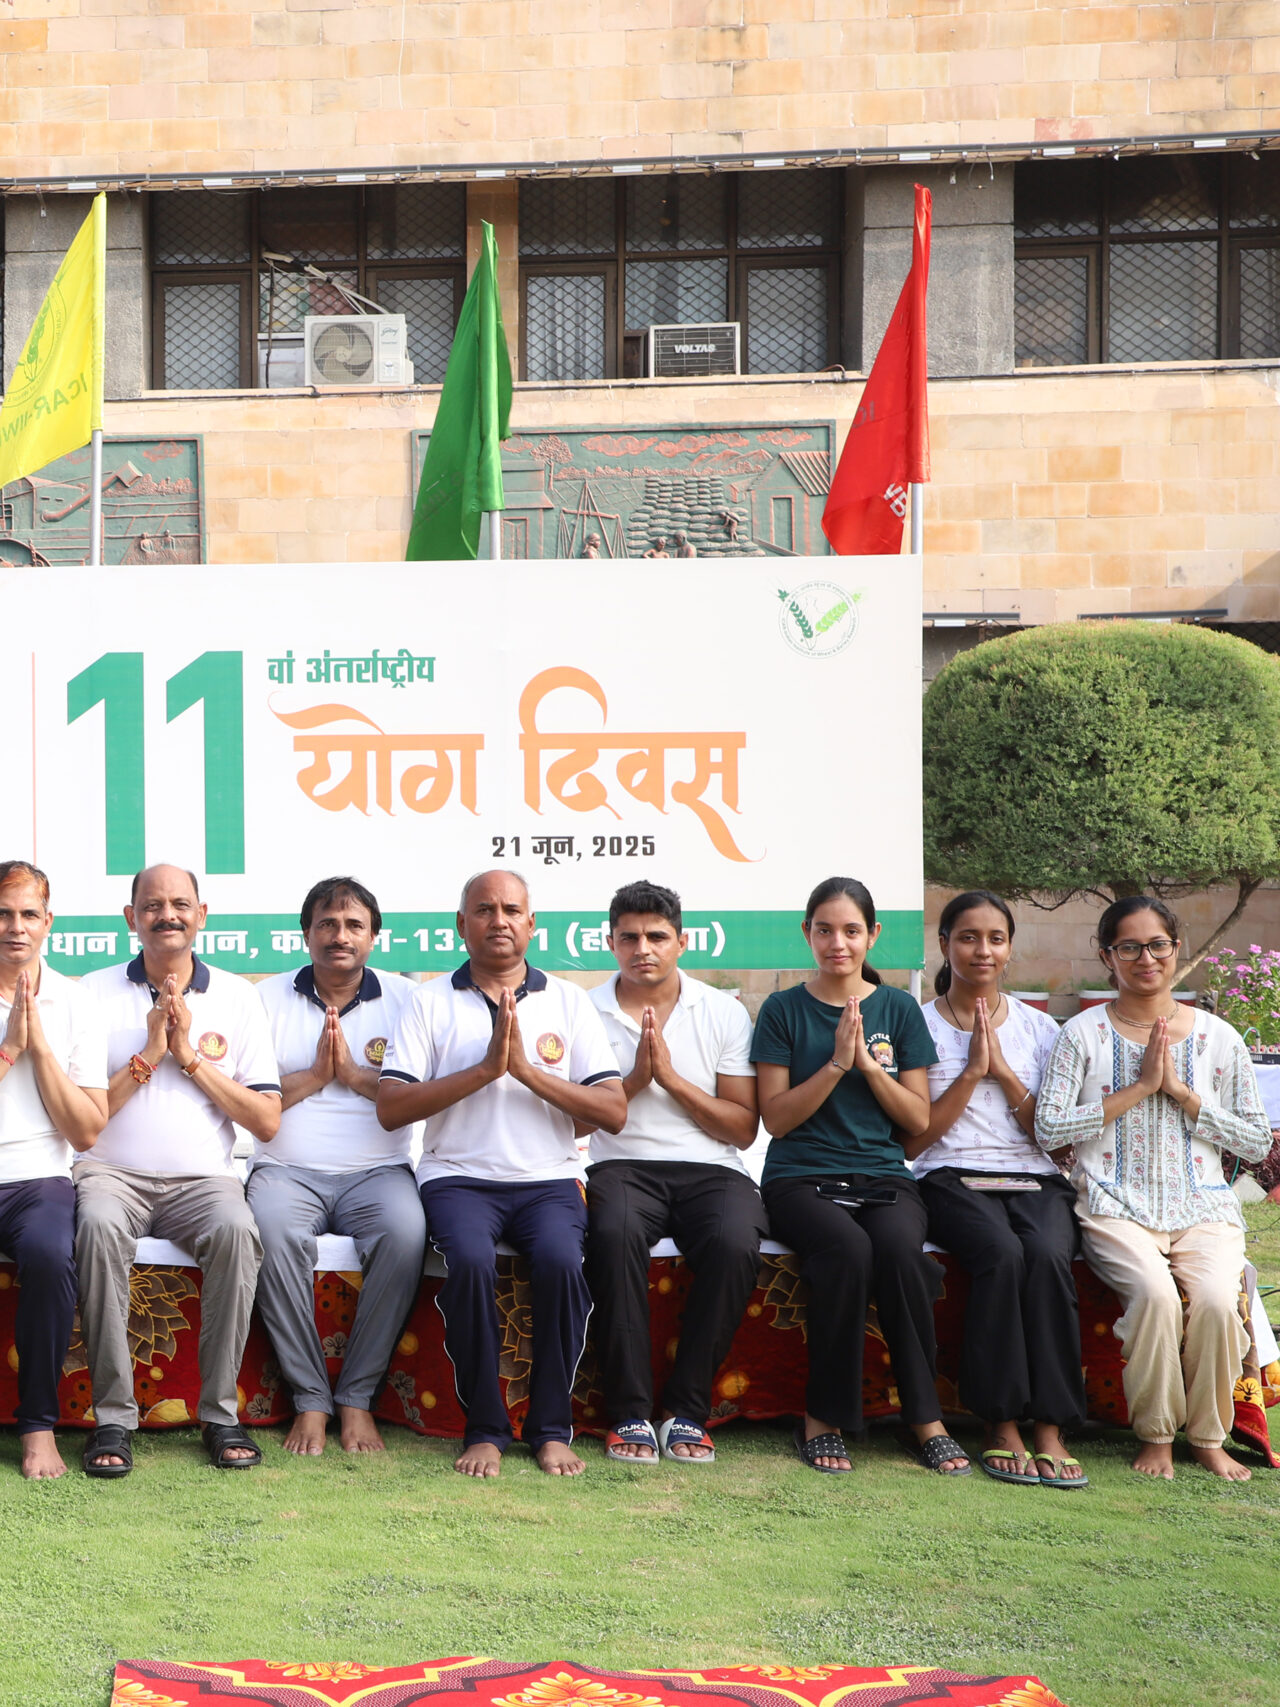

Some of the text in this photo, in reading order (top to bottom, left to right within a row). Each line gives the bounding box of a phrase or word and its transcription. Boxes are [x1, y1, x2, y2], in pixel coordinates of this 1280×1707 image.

[674, 343, 717, 354] VOLTAS
[267, 649, 436, 688] वां अंतर्राष्ट्रीय
[67, 651, 245, 876] 11
[267, 666, 767, 863] योग दिवस
[492, 835, 655, 865] 21 जून, 2025
